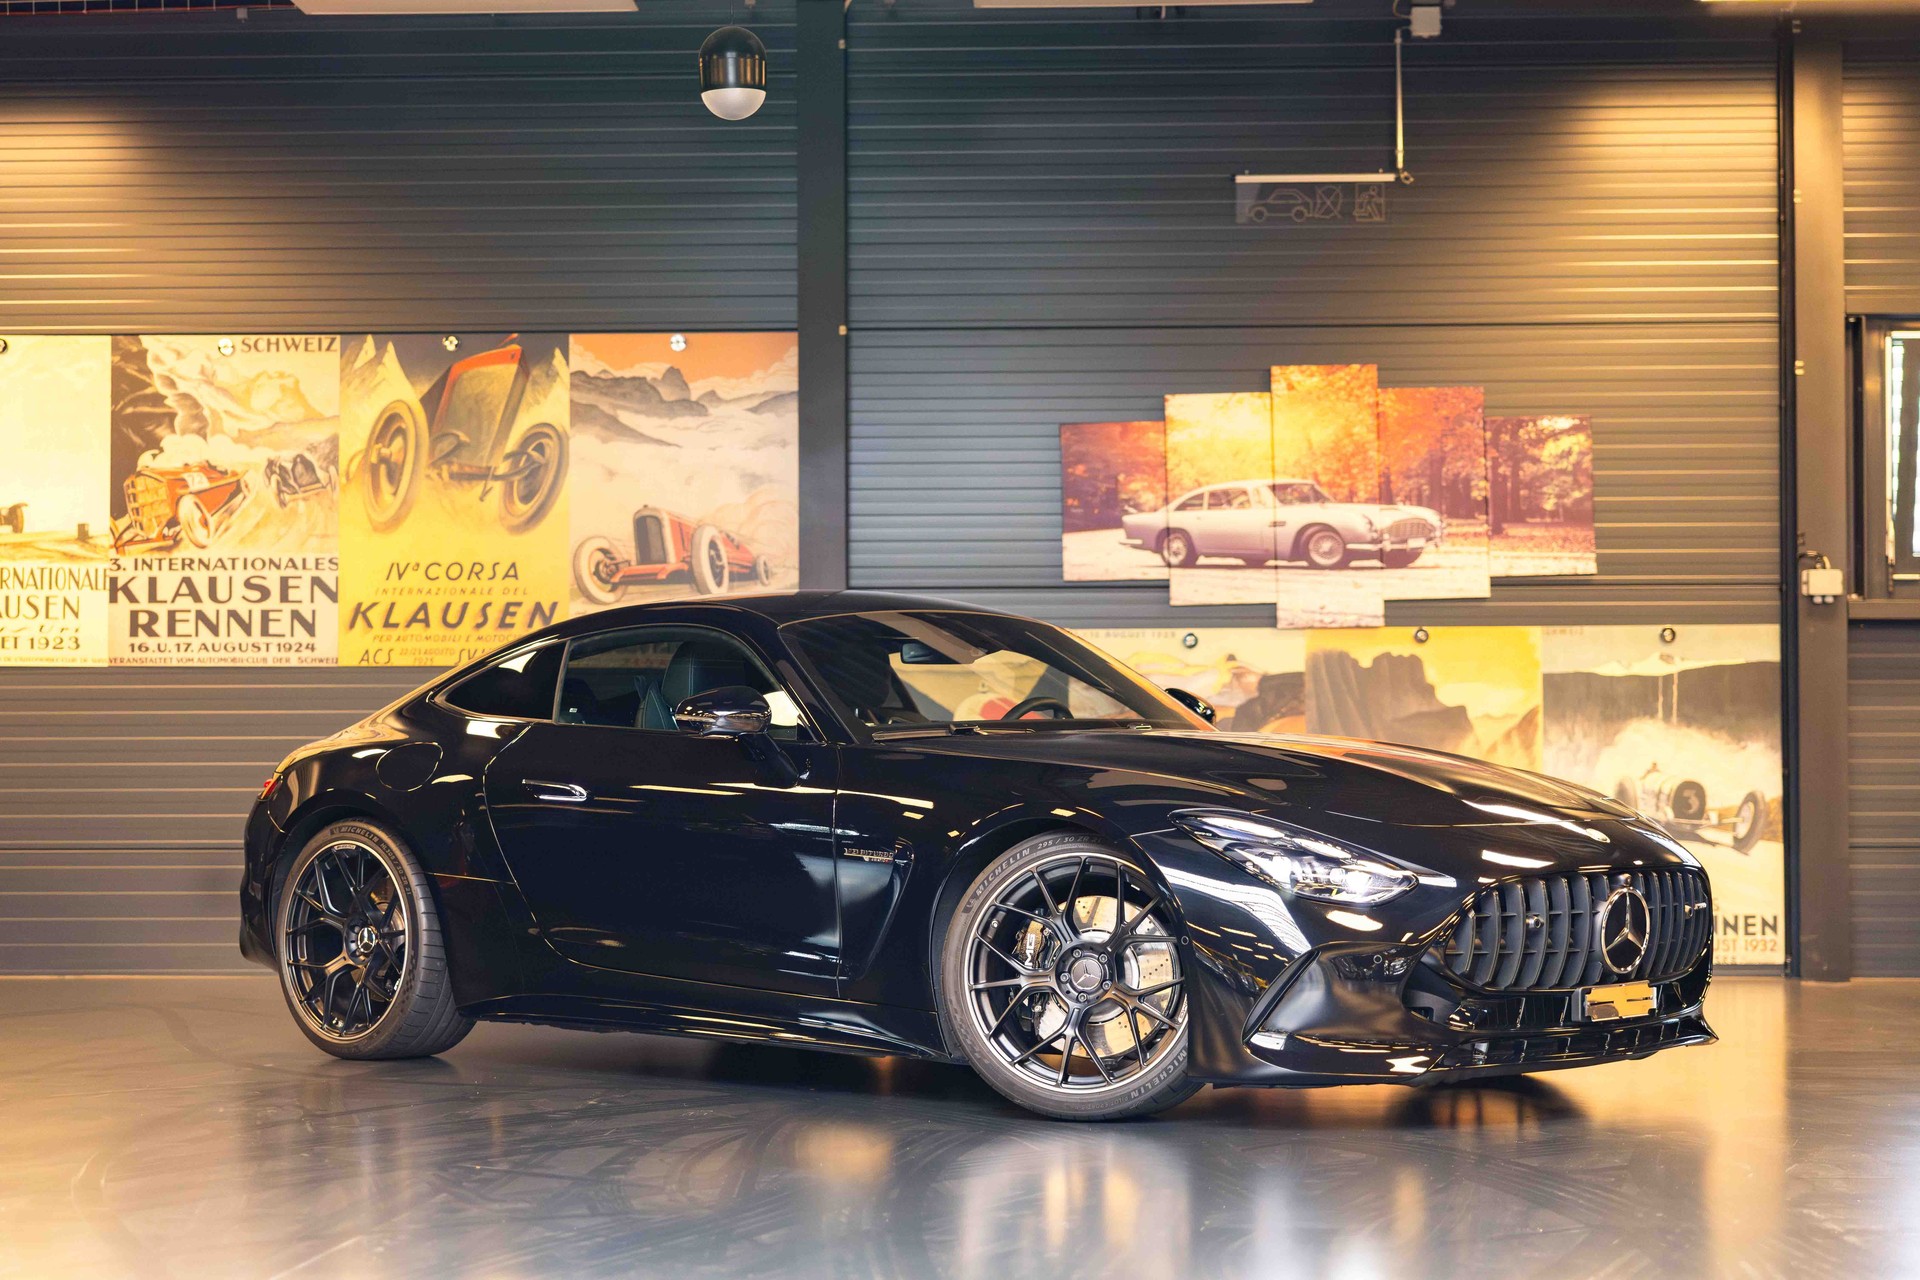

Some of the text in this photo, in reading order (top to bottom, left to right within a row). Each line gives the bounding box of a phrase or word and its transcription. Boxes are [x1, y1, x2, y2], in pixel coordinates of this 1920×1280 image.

[241, 337, 337, 352] SCHWEIZ
[109, 557, 338, 571] 3. INTERNATIONALES
[425, 562, 519, 580] CORSA
[109, 576, 338, 604] KLAUSEN
[375, 587, 528, 596] INTERNAZIONALE DEL
[0, 595, 80, 619] USEN
[129, 609, 316, 637] RENNEN
[349, 602, 558, 630] KLAUSEN
[29, 637, 80, 650] 1923
[373, 635, 393, 643] PER
[198, 642, 271, 653] AUGUST
[277, 642, 316, 653] 1924
[341, 827, 379, 842] MICHELIN
[1037, 840, 1053, 850] 295
[975, 848, 1031, 896] MICHELIN
[1744, 940, 1777, 952] 1932
[1130, 1050, 1187, 1099] MICHELIN
